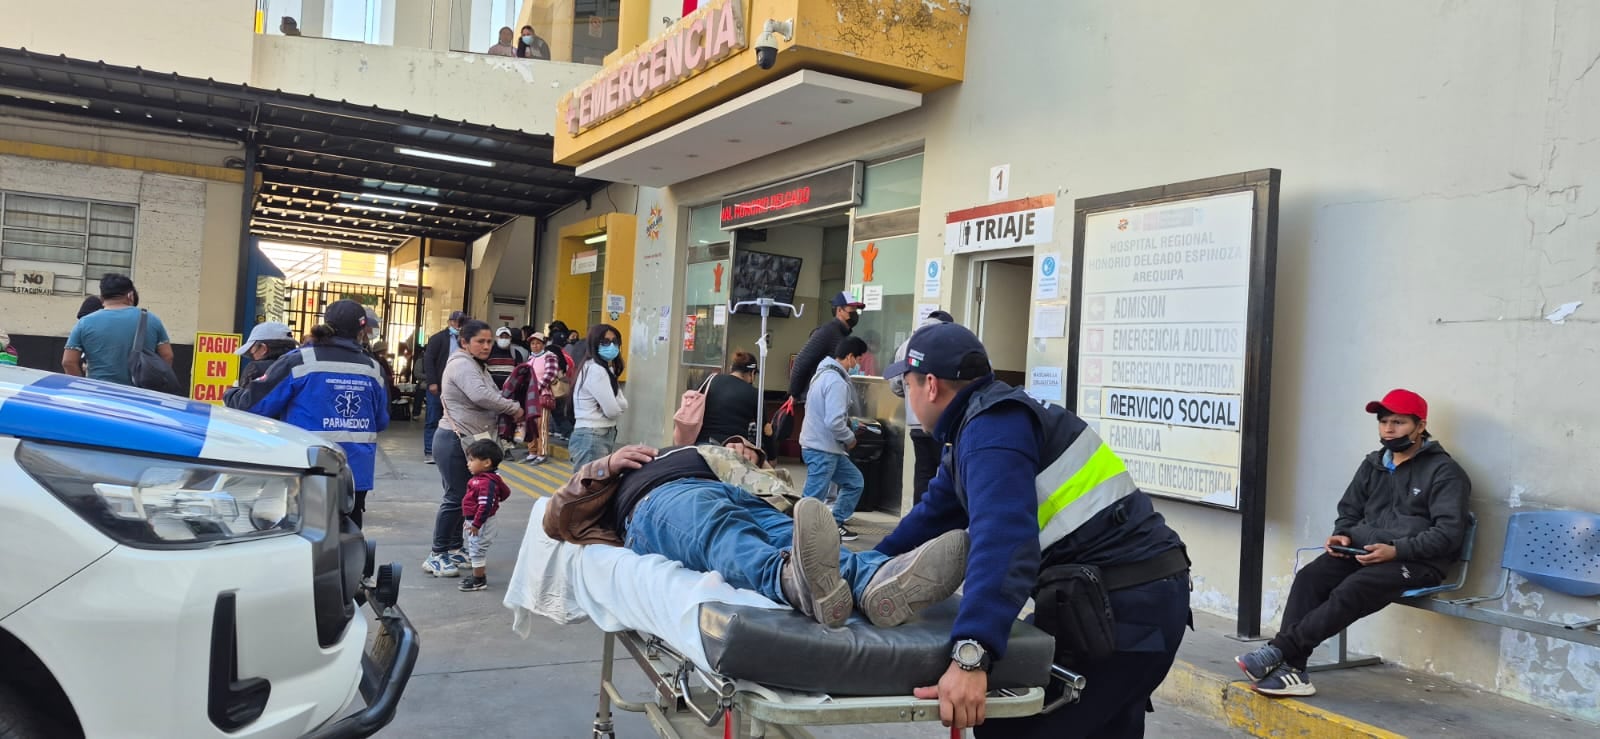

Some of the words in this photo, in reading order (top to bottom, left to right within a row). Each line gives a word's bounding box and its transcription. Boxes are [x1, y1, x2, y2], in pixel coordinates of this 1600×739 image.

[578, 0, 738, 129] EMERGENCIA
[996, 169, 1004, 192] 1
[770, 186, 811, 211] DELGADO
[975, 212, 1036, 243] TRIAJE
[1110, 237, 1158, 254] HOSPITAL
[1161, 231, 1215, 249] REGIONAL
[1089, 255, 1131, 270] HONORIO
[1134, 250, 1182, 267] DELGADO
[1185, 246, 1242, 263] ESPINOZA
[23, 273, 43, 285] NO
[1132, 268, 1184, 283] AREQUIPA
[1114, 295, 1166, 319] ADMISION
[198, 336, 239, 354] PAGUE
[1112, 328, 1179, 351] EMERGENCIA
[1184, 328, 1239, 353] ADULTOS
[207, 360, 227, 377] EN
[1111, 360, 1170, 385] EMERGENCIA
[1174, 362, 1236, 388] PEDIATRICA
[194, 383, 233, 401] CAJ
[1178, 398, 1236, 426] SOCIAL
[1109, 424, 1161, 452] FARMACIA
